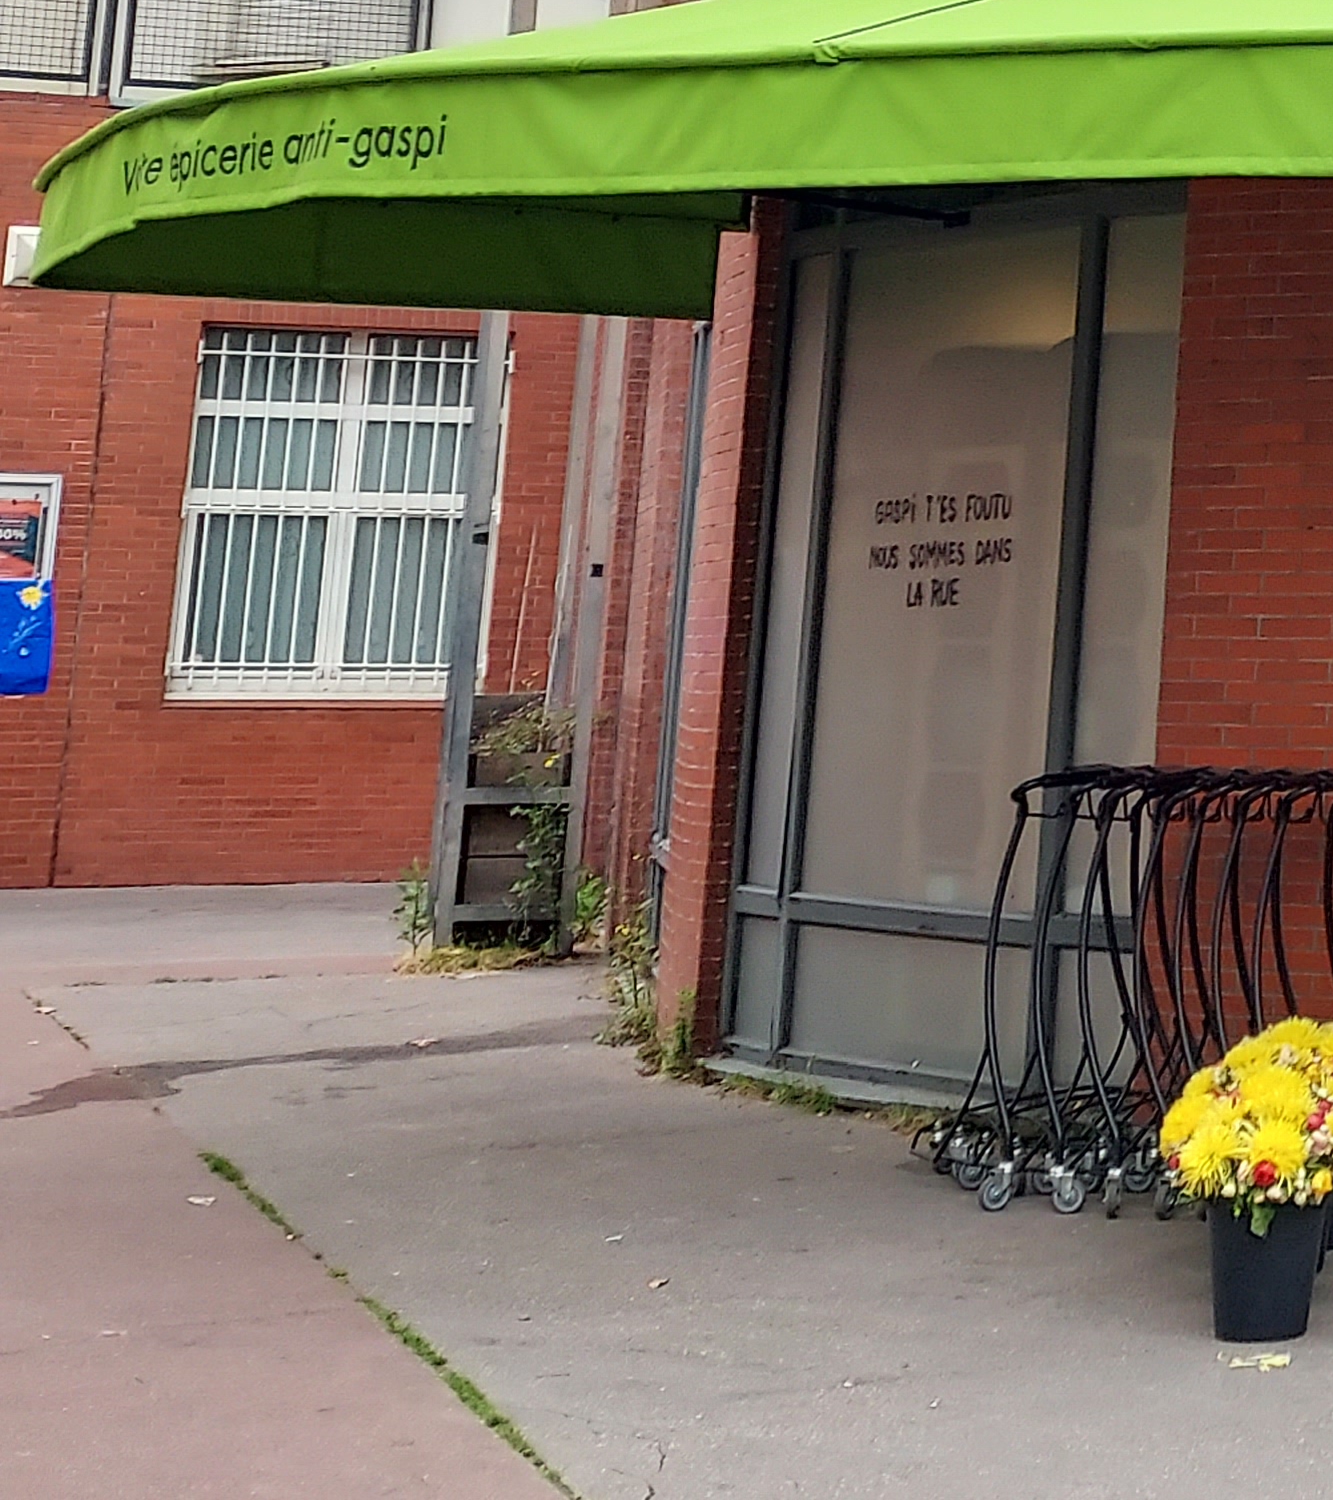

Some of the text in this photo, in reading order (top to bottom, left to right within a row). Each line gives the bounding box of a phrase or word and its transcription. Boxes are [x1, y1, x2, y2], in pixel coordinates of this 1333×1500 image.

[170, 132, 273, 192] épicerie
[283, 114, 447, 170] anti-gaspi
[965, 493, 1012, 522] FOUTU
[909, 540, 965, 570] SOMMES
[975, 538, 1012, 565] DANS
[906, 578, 960, 607] LA RUE
